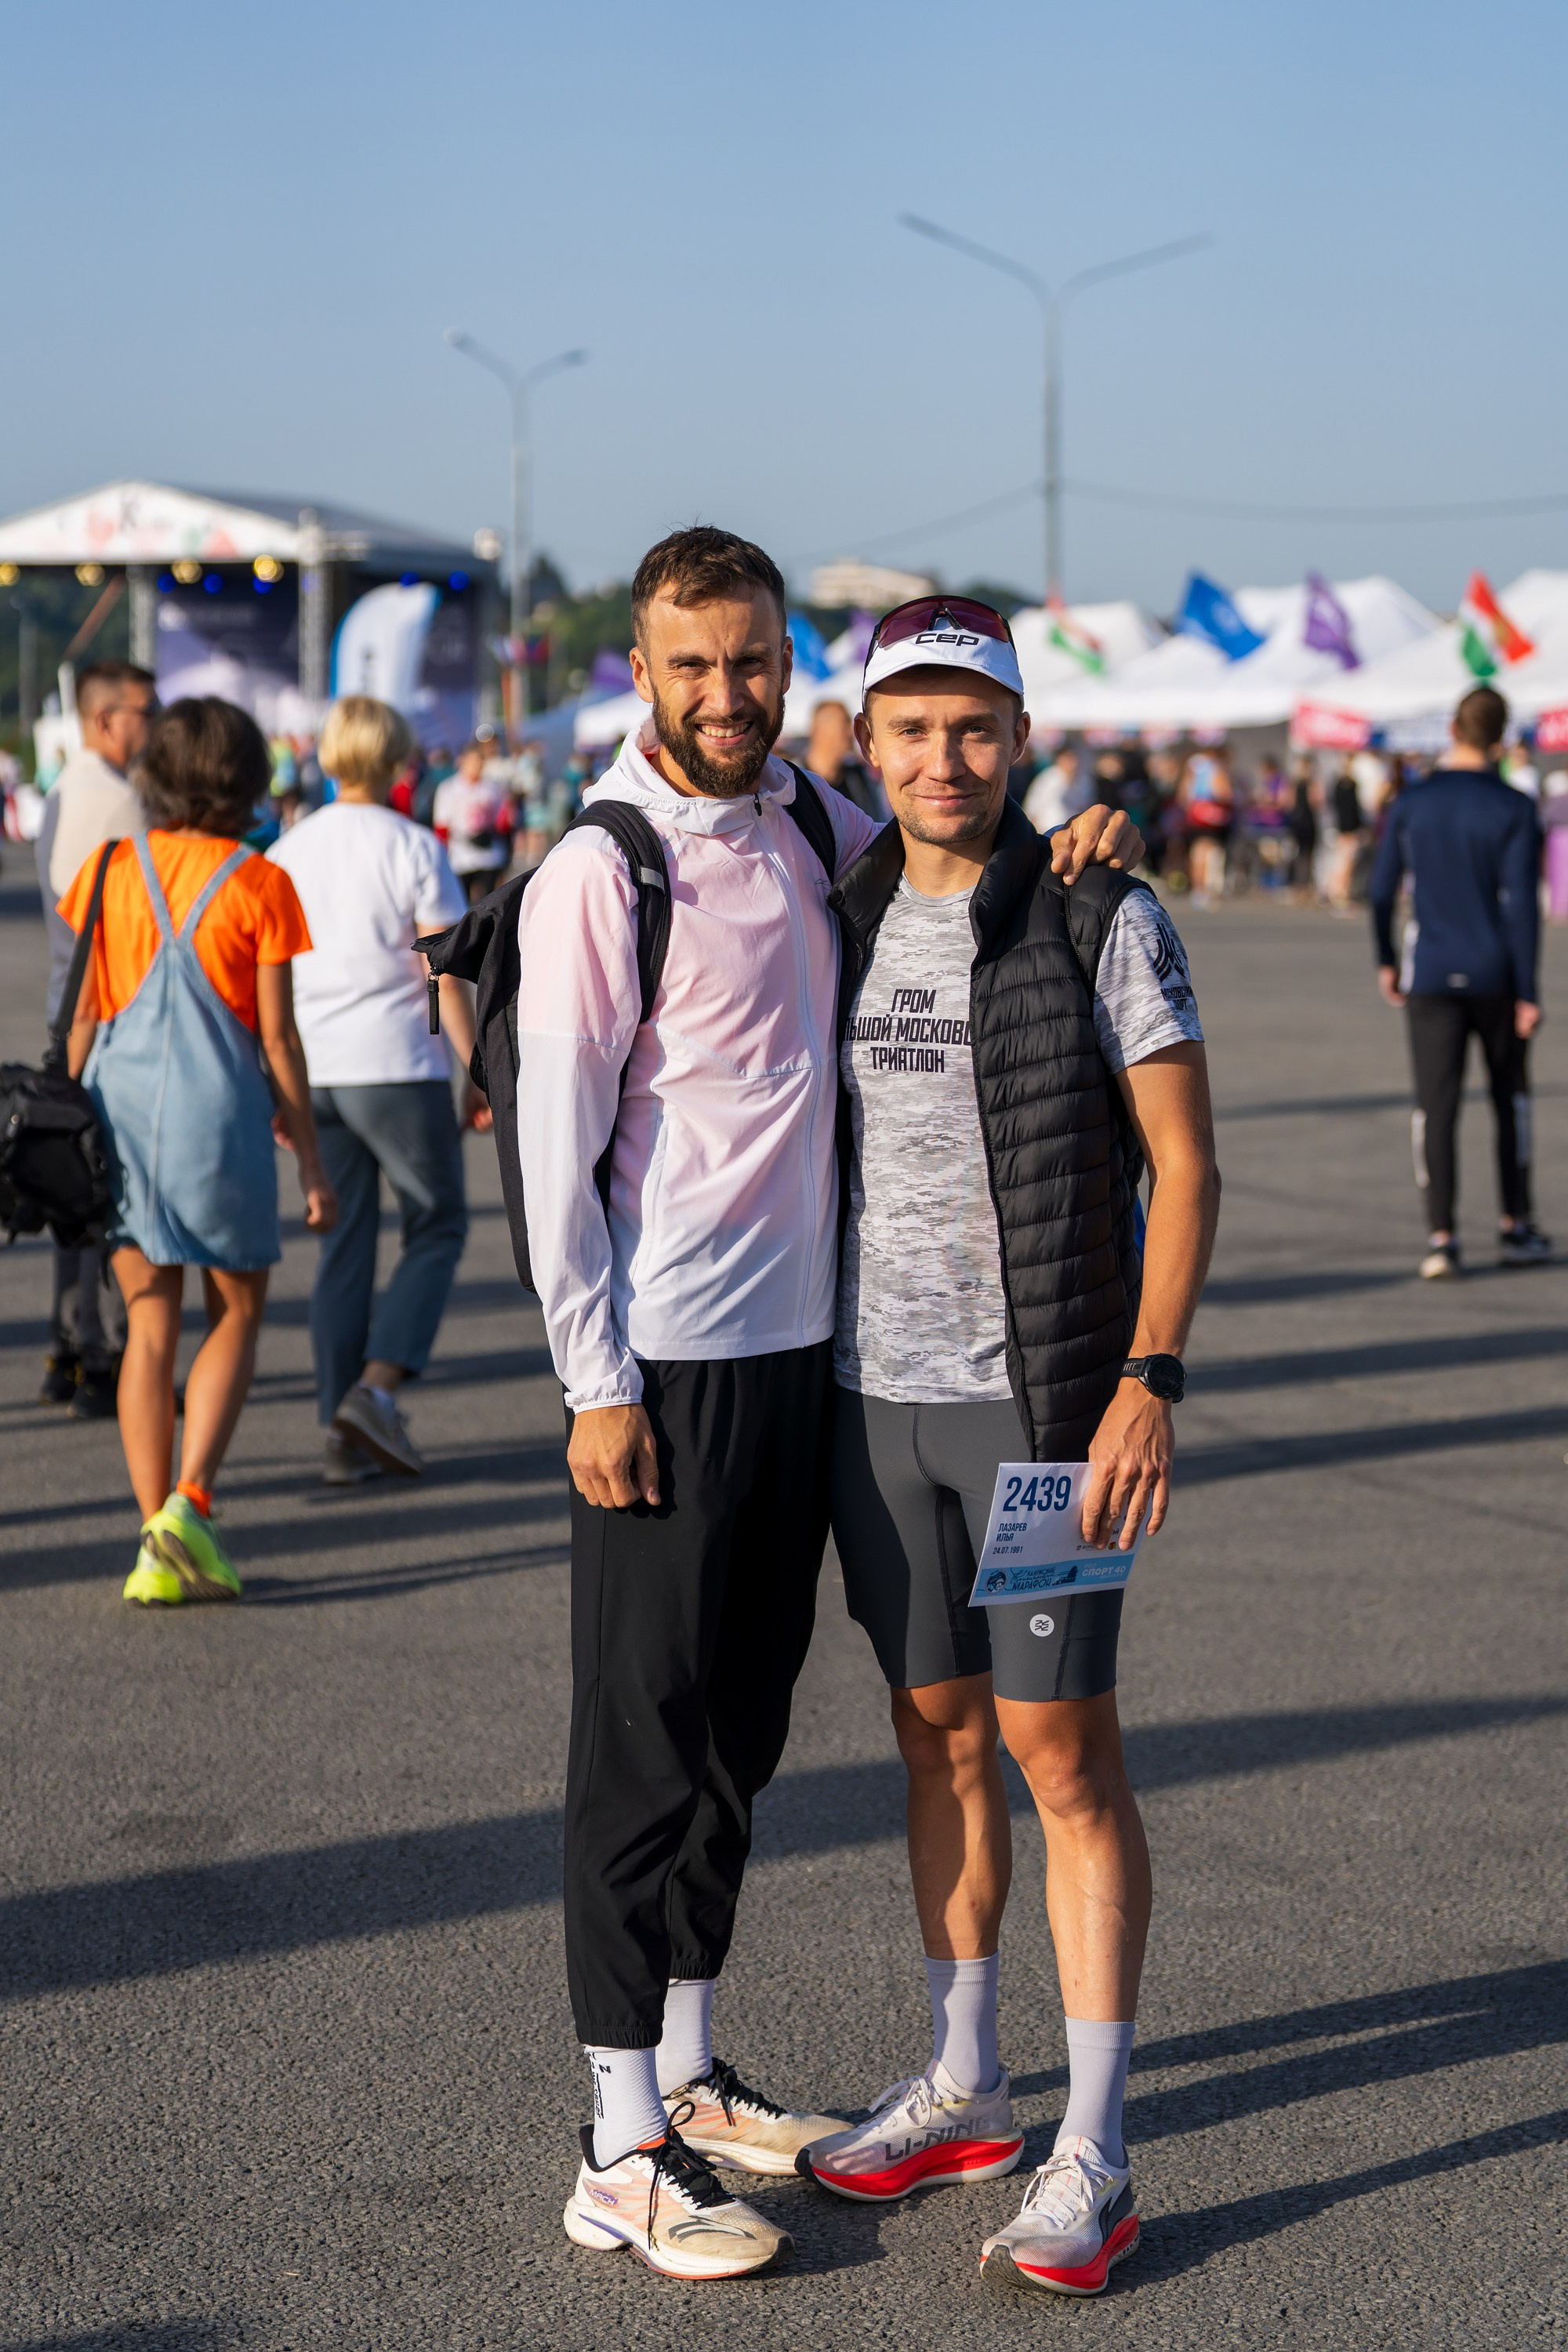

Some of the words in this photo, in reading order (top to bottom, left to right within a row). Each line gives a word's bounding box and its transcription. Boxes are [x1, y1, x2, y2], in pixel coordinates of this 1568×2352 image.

[891, 989, 936, 1013] ГРОМ
[870, 1047, 945, 1073] ТРИАТЛОН
[1003, 1475, 1072, 1512] 2439
[998, 1523, 1027, 1532] ЛАЗАРЕВ
[996, 1533, 1014, 1542] ИЛЬЯ
[993, 1545, 1023, 1555] 24.07.1991
[1082, 1566, 1113, 1577] СПОРТ
[1012, 1577, 1052, 1592] МАРАФОН
[589, 2189, 615, 2206] MACH
